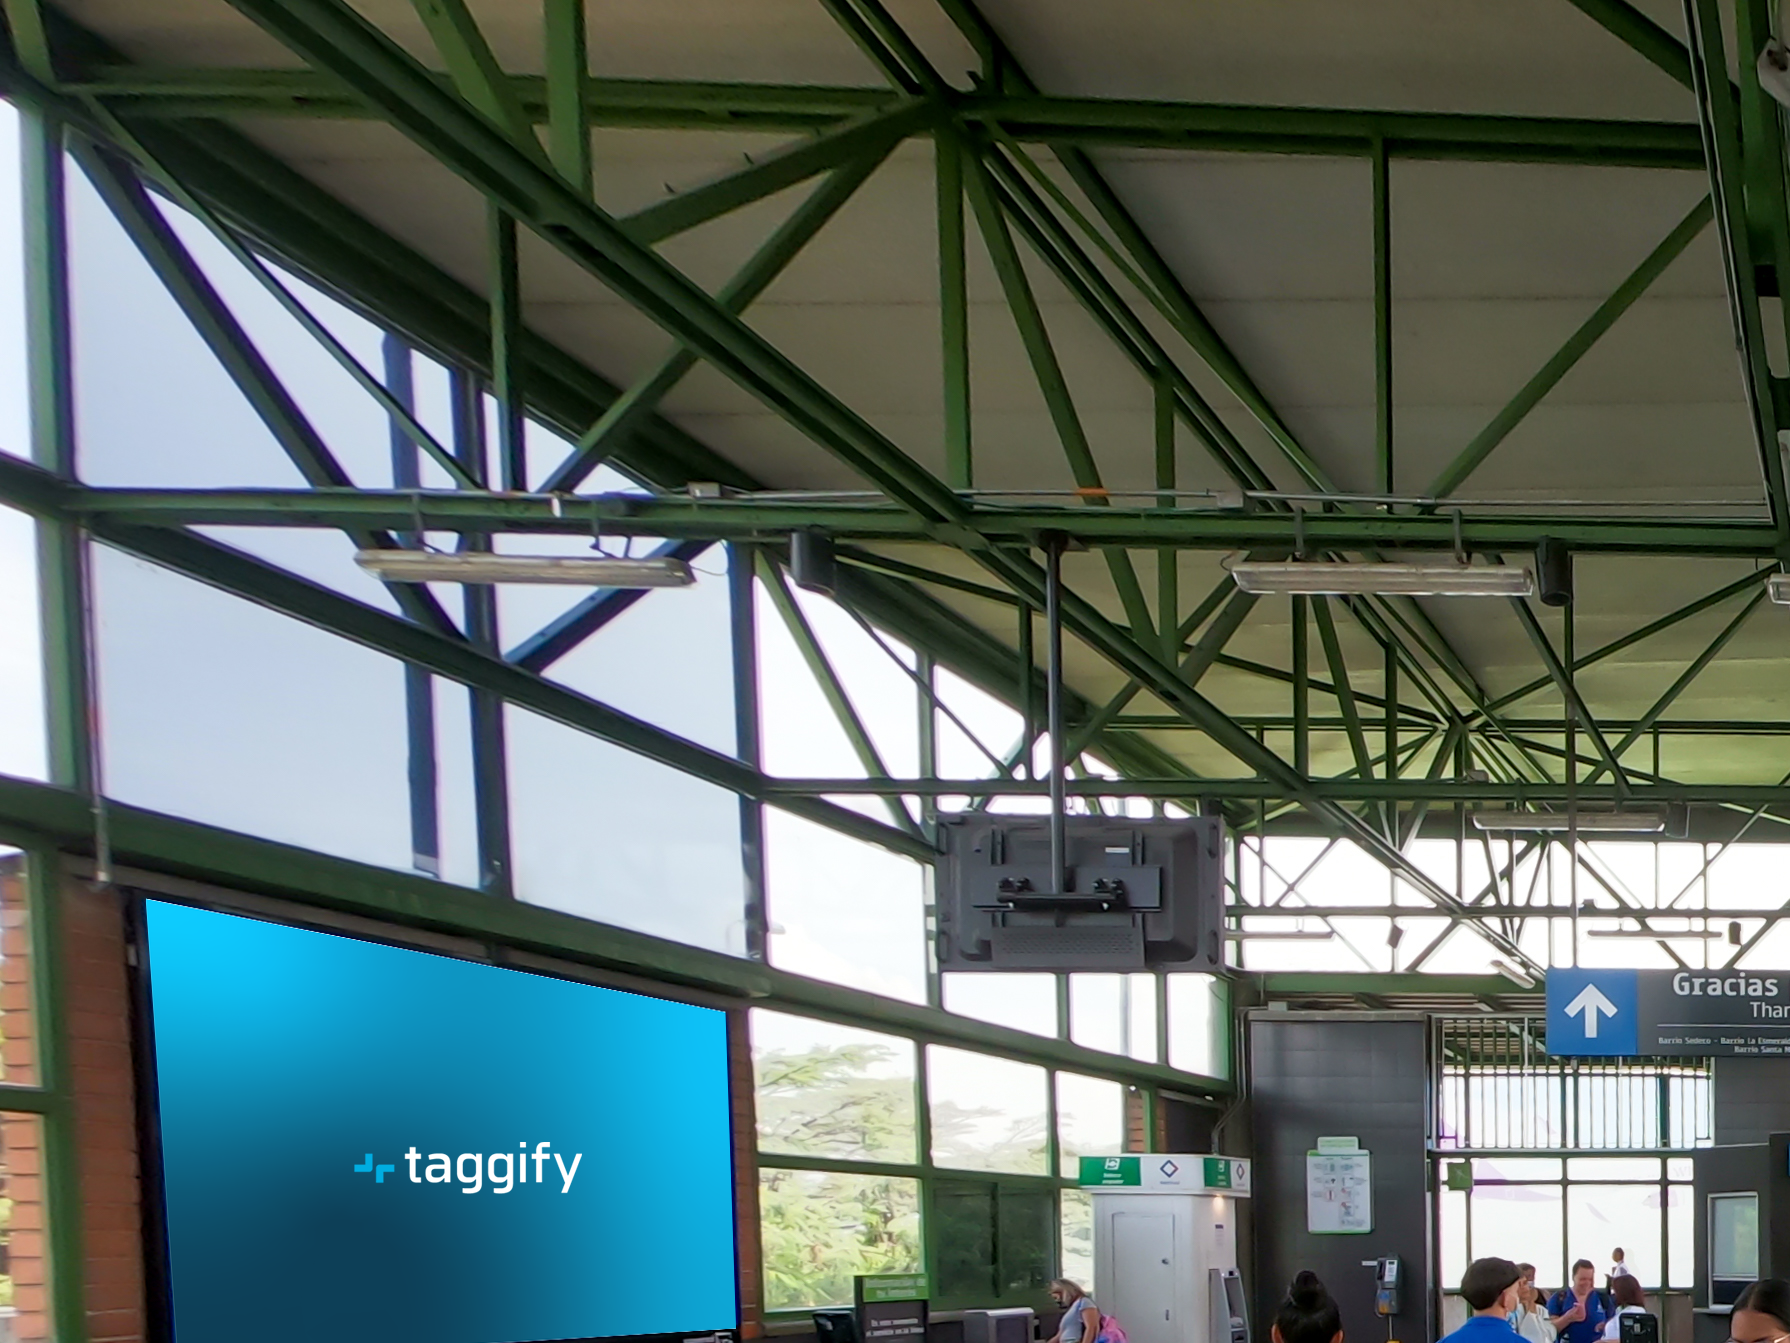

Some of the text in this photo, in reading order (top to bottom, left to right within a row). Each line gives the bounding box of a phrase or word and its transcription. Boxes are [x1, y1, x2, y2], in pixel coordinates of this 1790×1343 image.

[1672, 972, 1778, 997] Gracias
[1658, 1037, 1683, 1045] Barrio
[1721, 1037, 1745, 1045] Barrio
[1748, 1037, 1756, 1045] La
[404, 1141, 583, 1194] taggify
